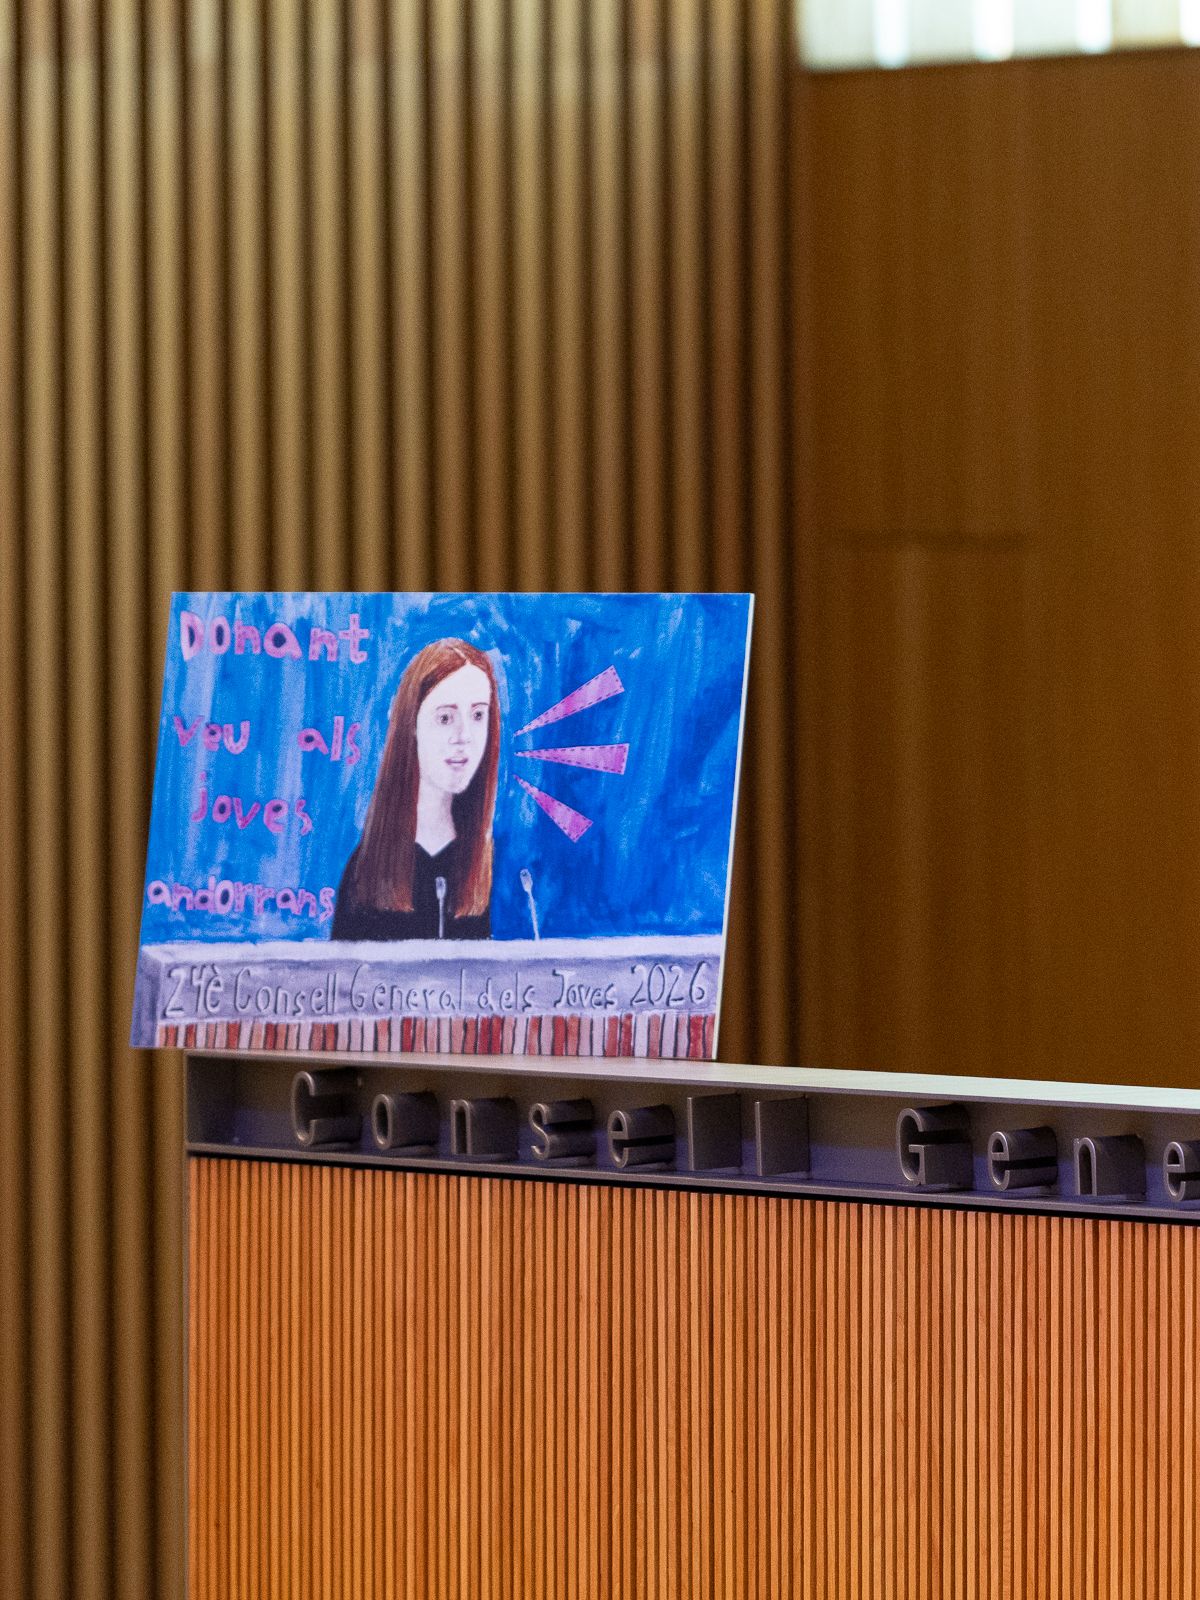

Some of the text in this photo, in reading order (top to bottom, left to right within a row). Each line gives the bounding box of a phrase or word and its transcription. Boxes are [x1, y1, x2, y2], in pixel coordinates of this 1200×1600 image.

[297, 715, 362, 766] als
[191, 771, 313, 836] joves
[163, 960, 709, 1018] 24è Consell General dels Joves 2026
[290, 1069, 780, 1178] Consell
